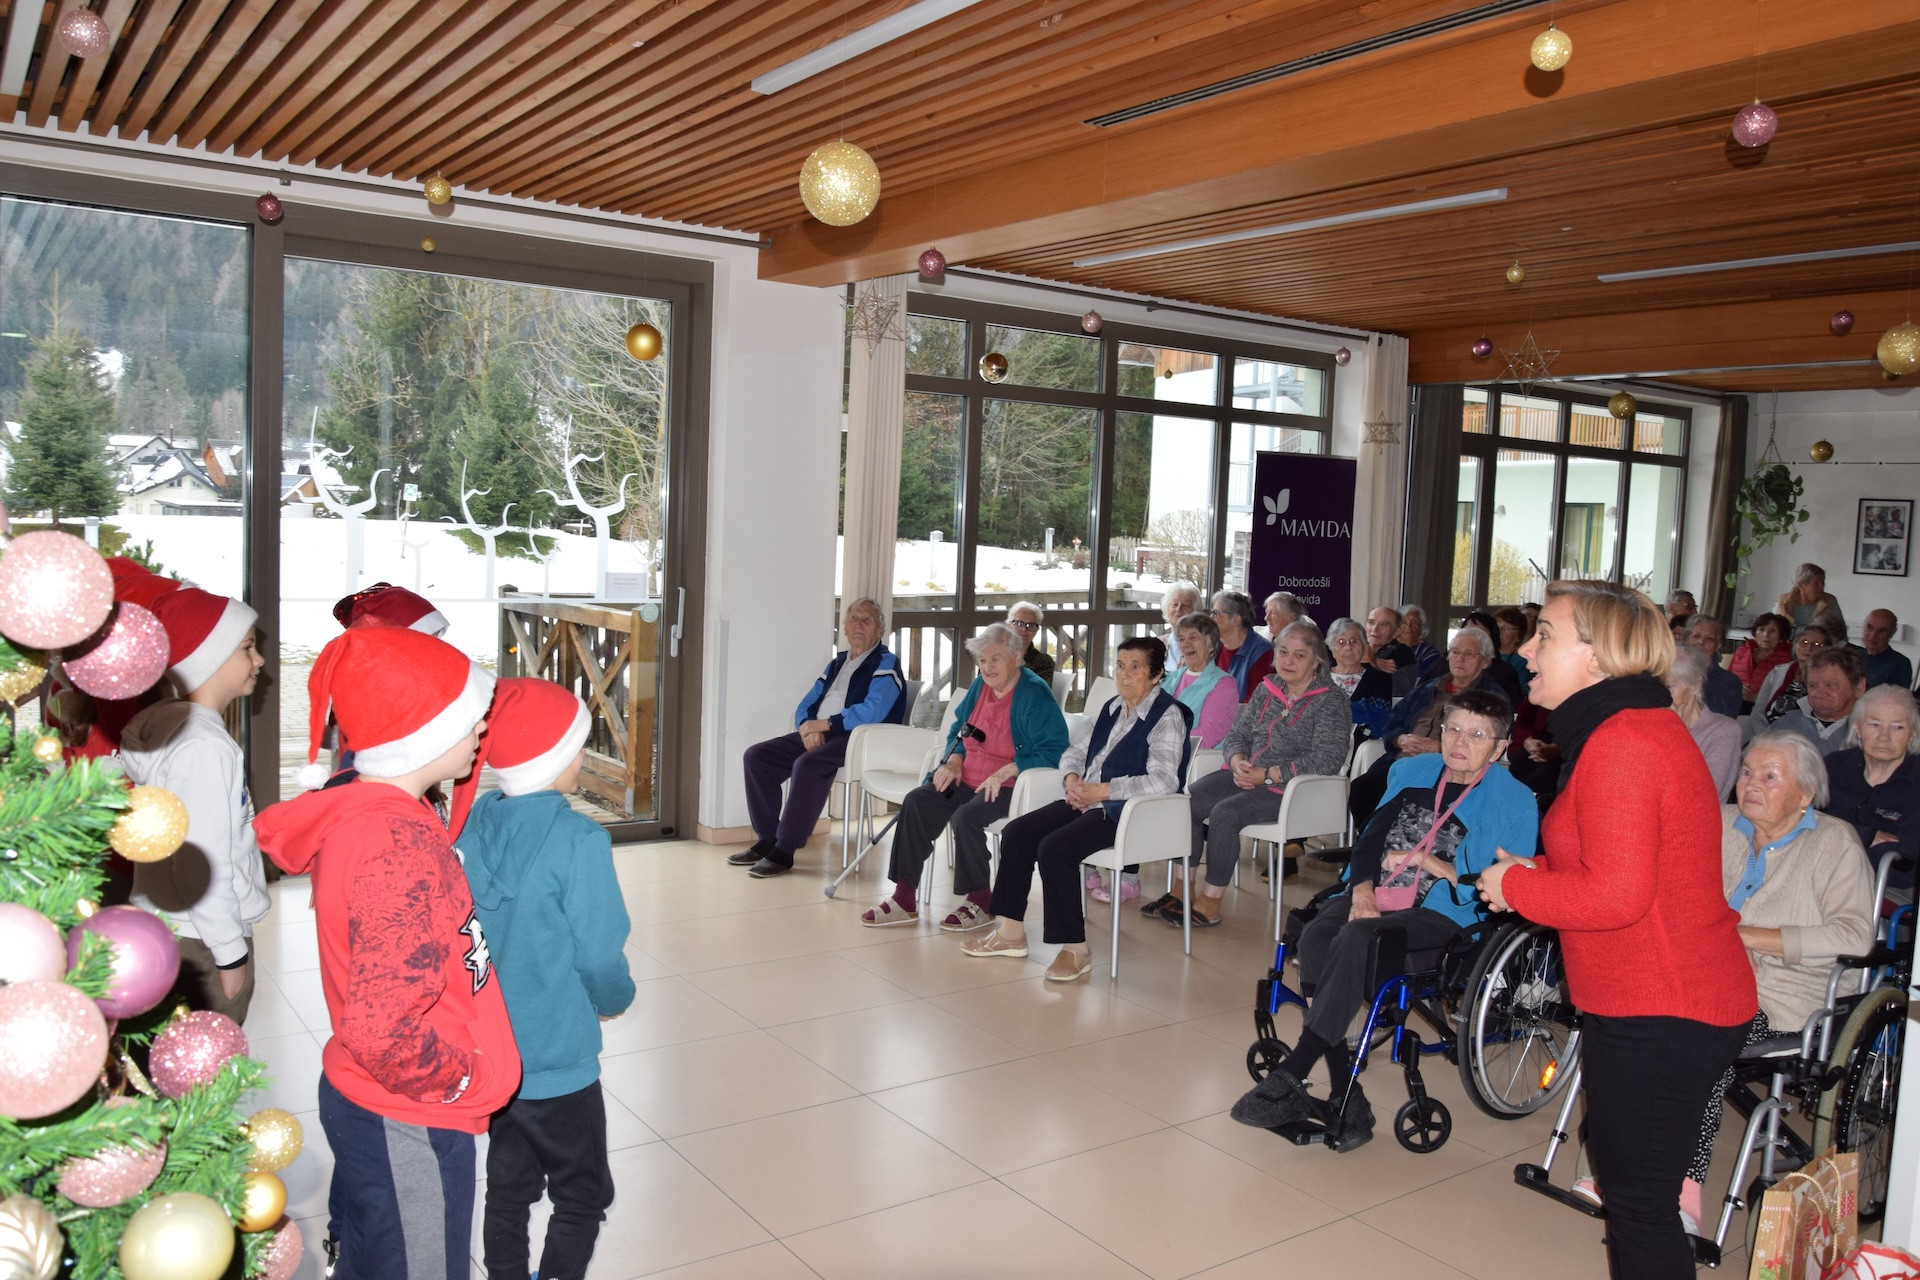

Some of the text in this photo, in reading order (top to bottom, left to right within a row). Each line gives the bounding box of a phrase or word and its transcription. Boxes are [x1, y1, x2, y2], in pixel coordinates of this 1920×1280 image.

[1280, 518, 1351, 539] MAVIDA
[1278, 575, 1331, 588] Dobrodošli
[1292, 593, 1321, 605] avida
